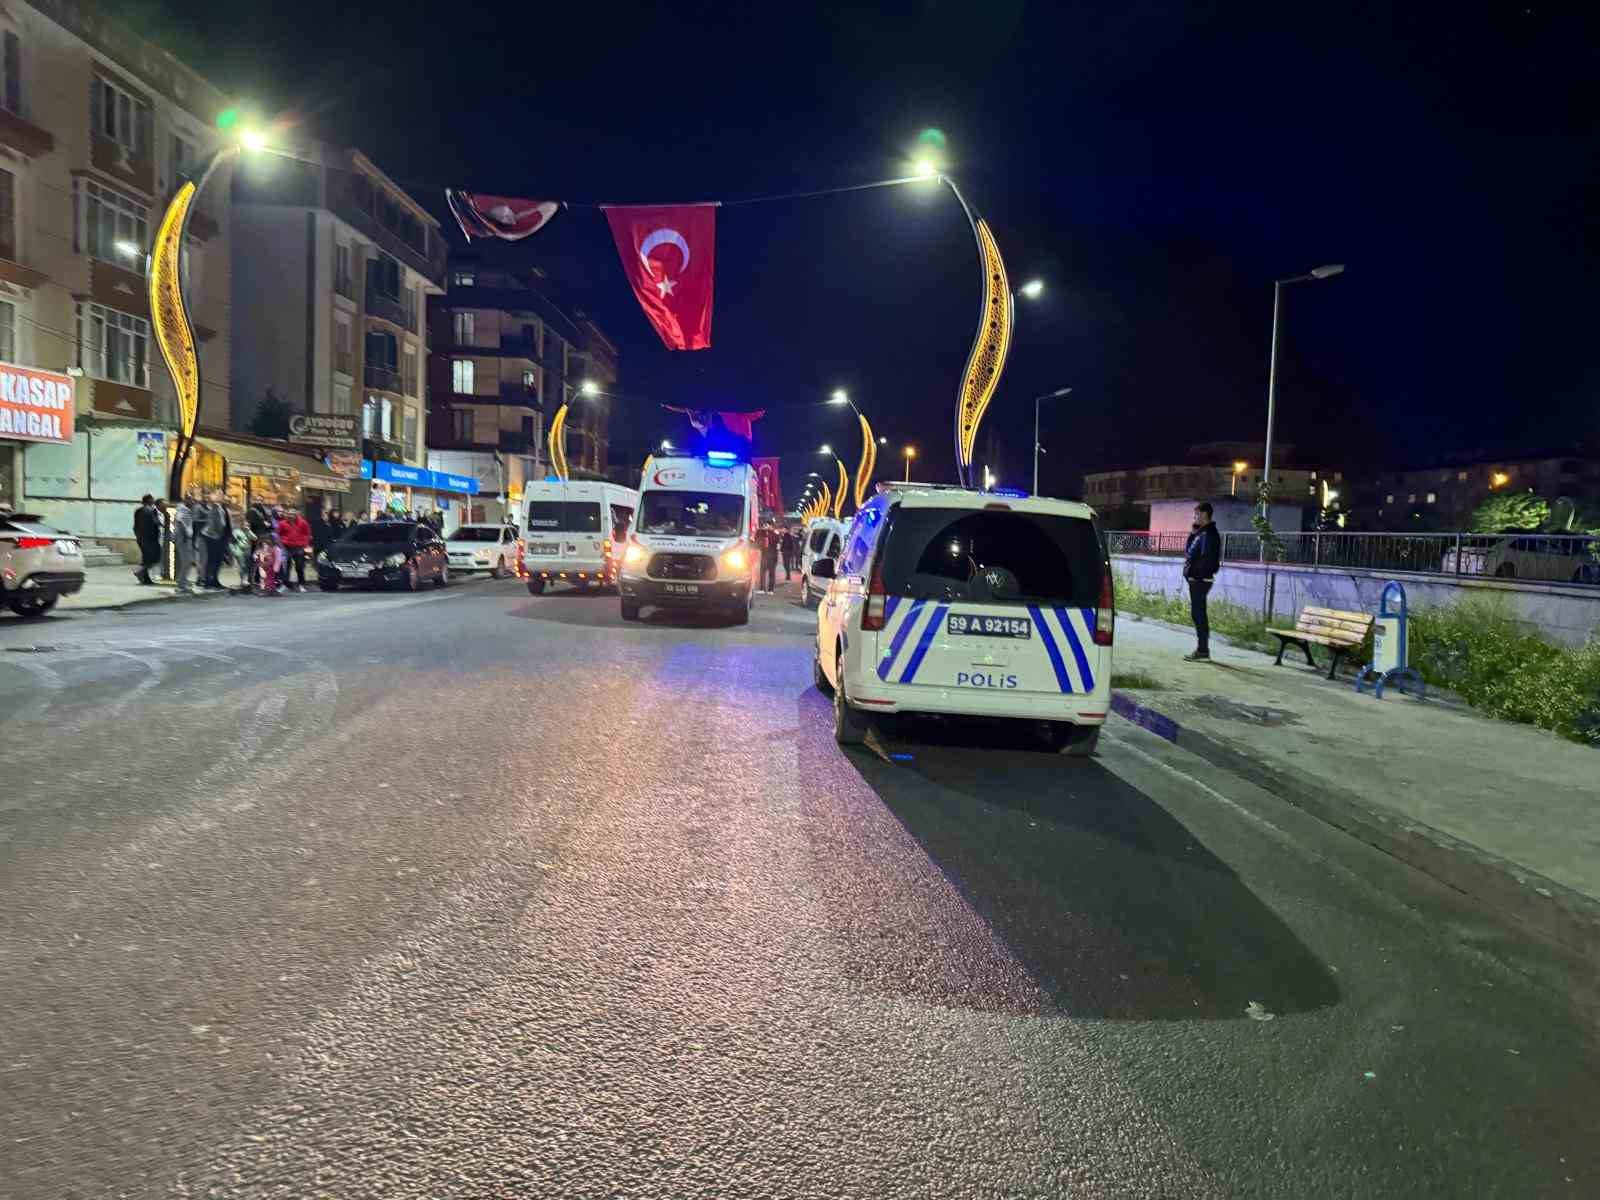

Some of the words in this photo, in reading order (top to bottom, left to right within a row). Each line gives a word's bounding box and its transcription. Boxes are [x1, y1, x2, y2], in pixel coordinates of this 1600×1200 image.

[0, 373, 70, 409] KASAP
[950, 616, 967, 630] 59
[970, 618, 981, 631] A
[985, 619, 1028, 634] 92154
